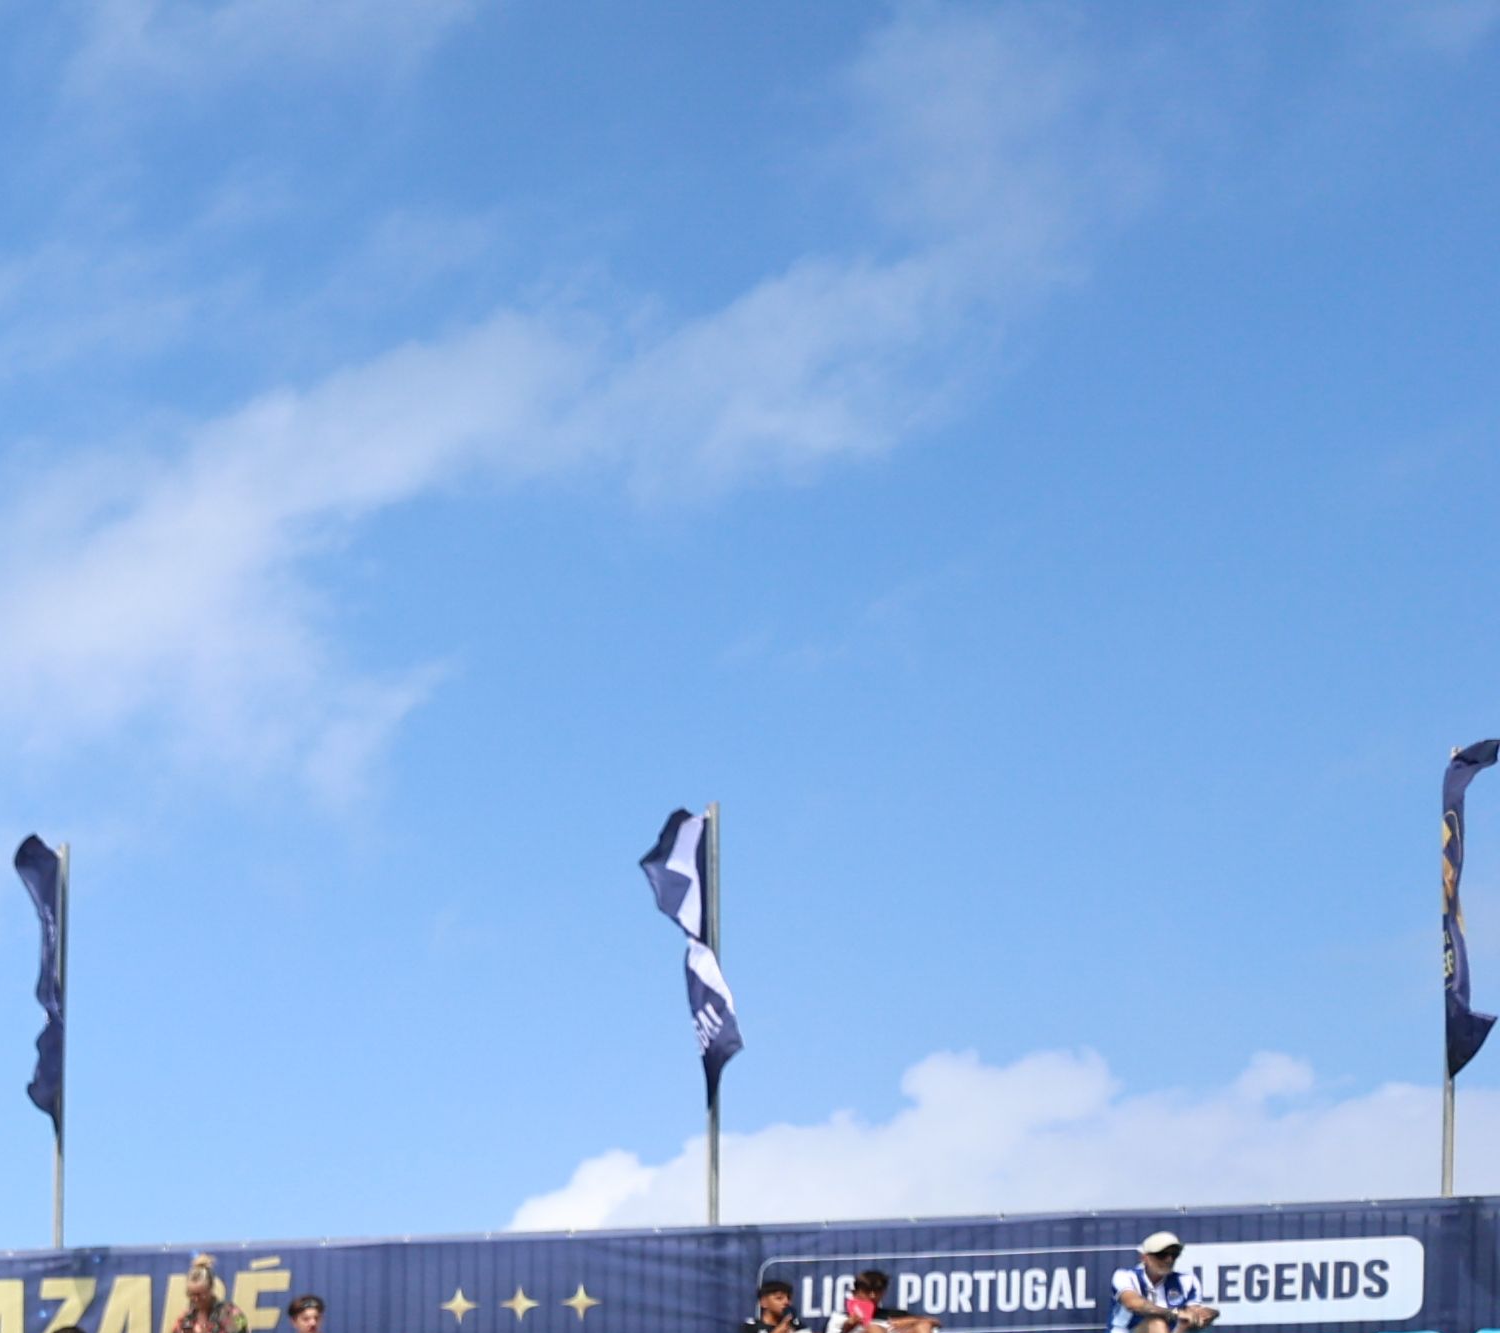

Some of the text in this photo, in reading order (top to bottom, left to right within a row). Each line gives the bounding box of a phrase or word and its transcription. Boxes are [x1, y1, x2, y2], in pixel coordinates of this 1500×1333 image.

[802, 1267, 1096, 1318] LIG PORTUGAL
[1193, 1259, 1390, 1304] LEGENDS
